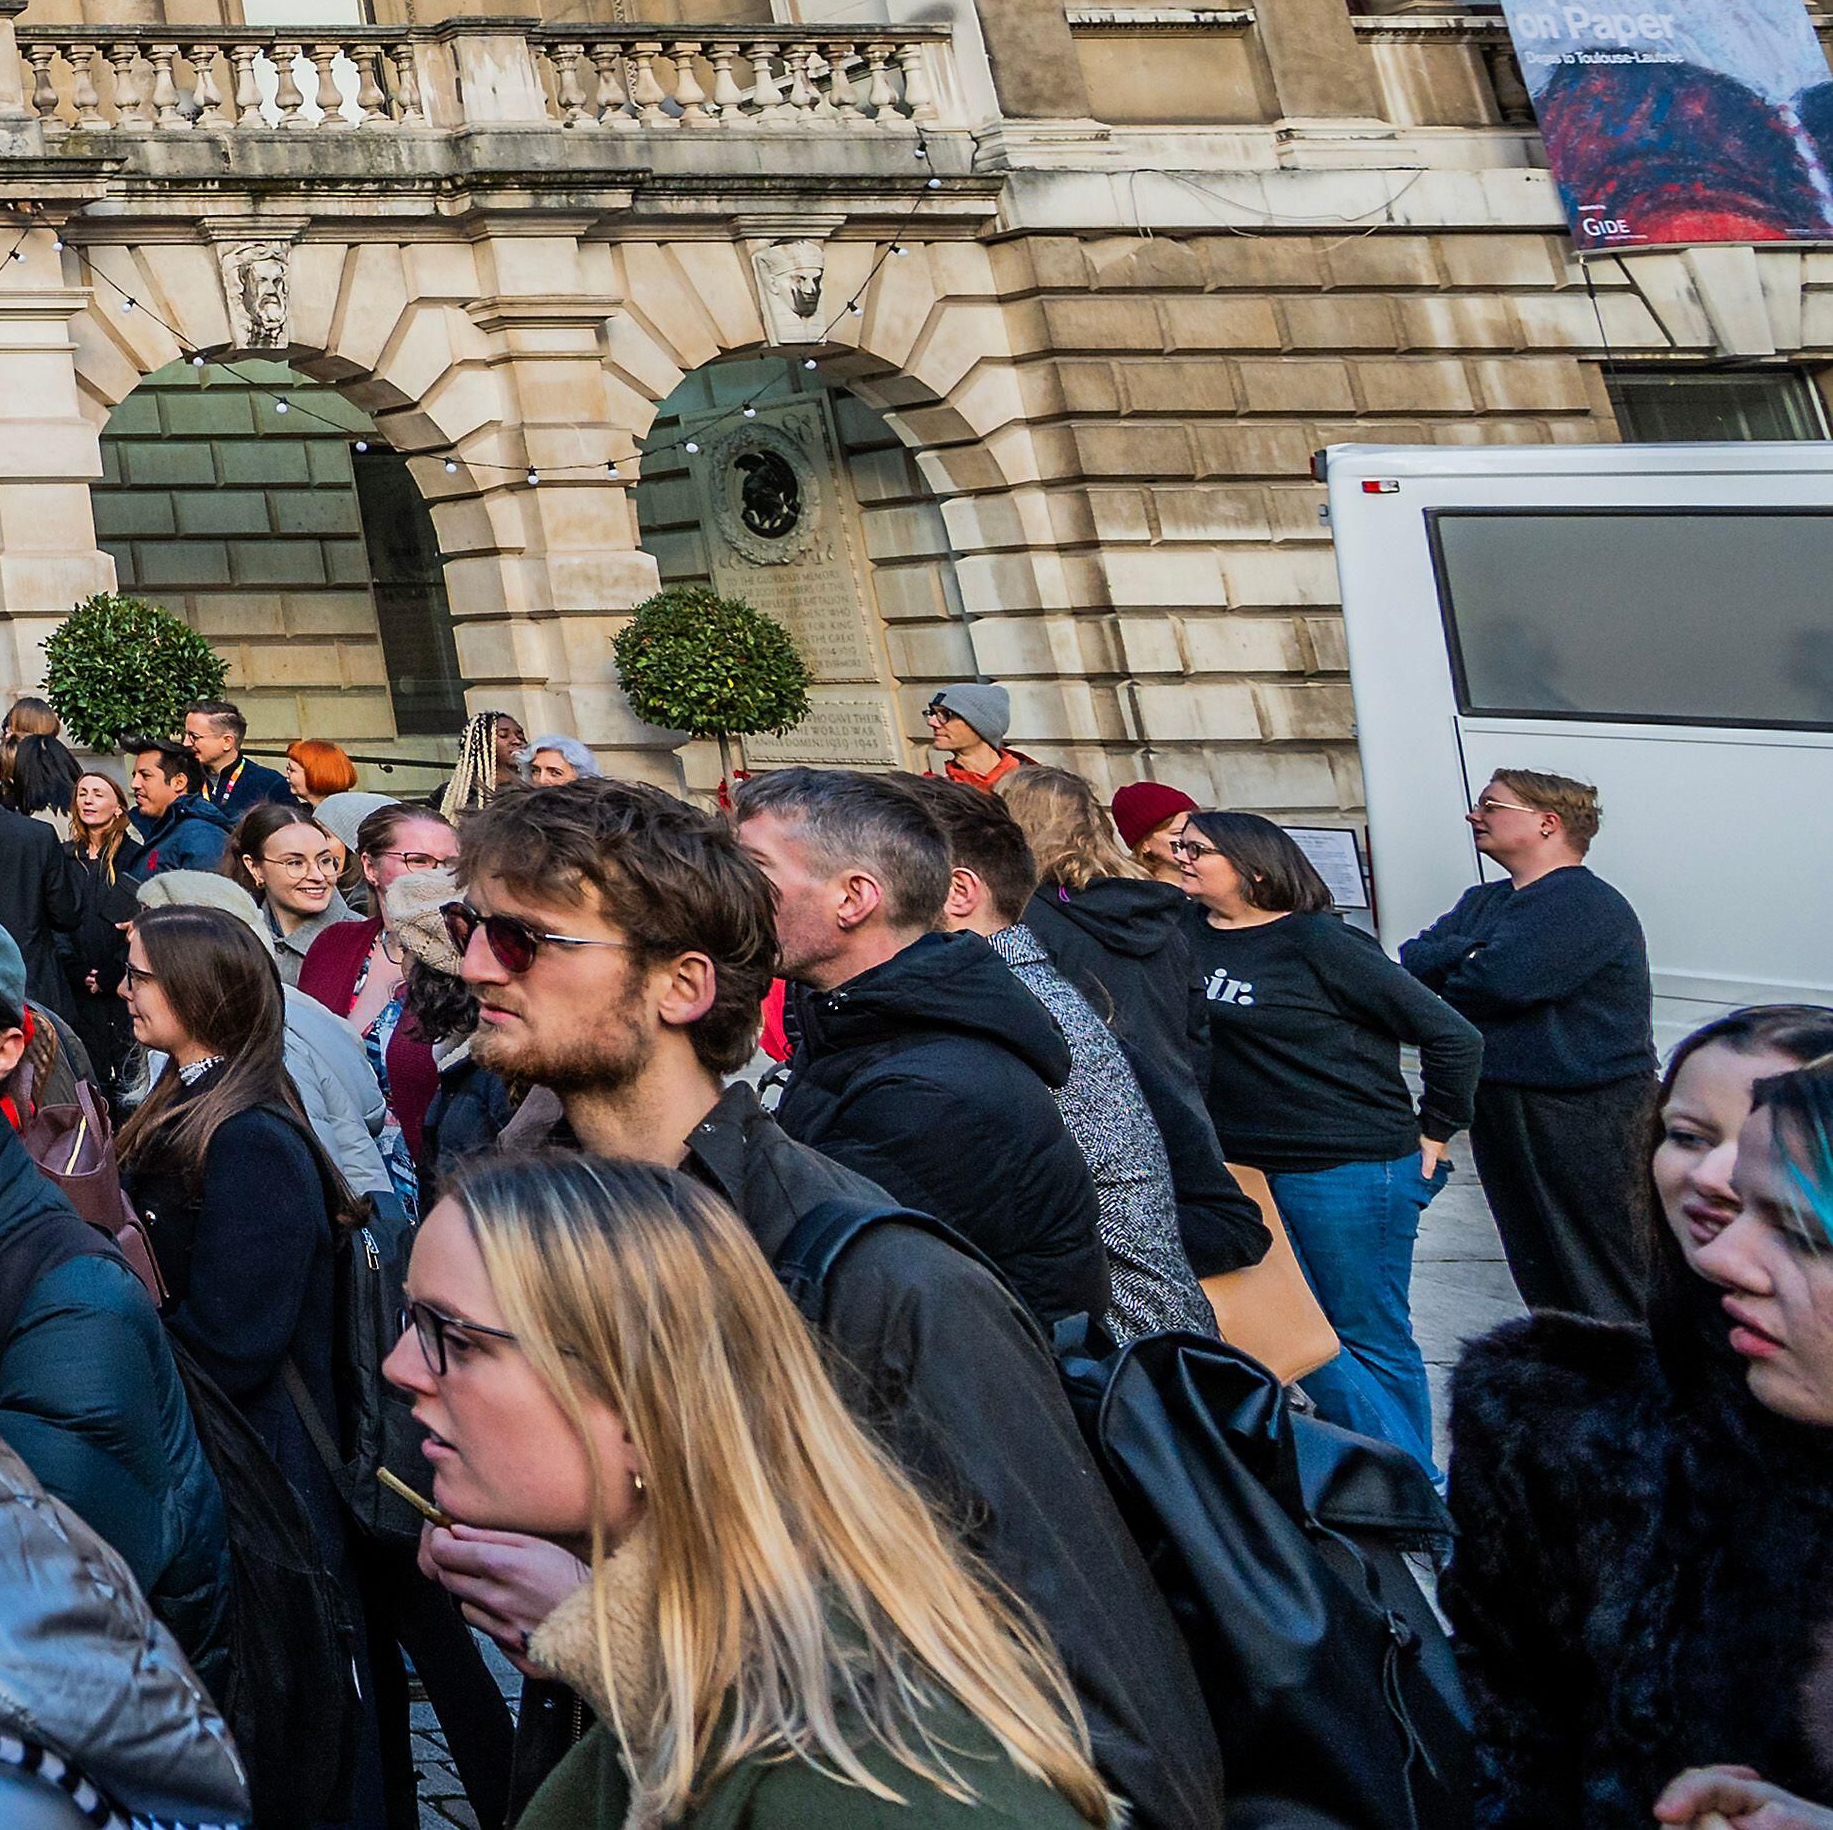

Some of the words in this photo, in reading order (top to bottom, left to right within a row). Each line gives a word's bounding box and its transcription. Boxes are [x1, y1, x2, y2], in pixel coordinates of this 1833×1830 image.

[1515, 13, 1561, 40] on
[1563, 5, 1675, 47] Paper
[1563, 52, 1575, 65] to
